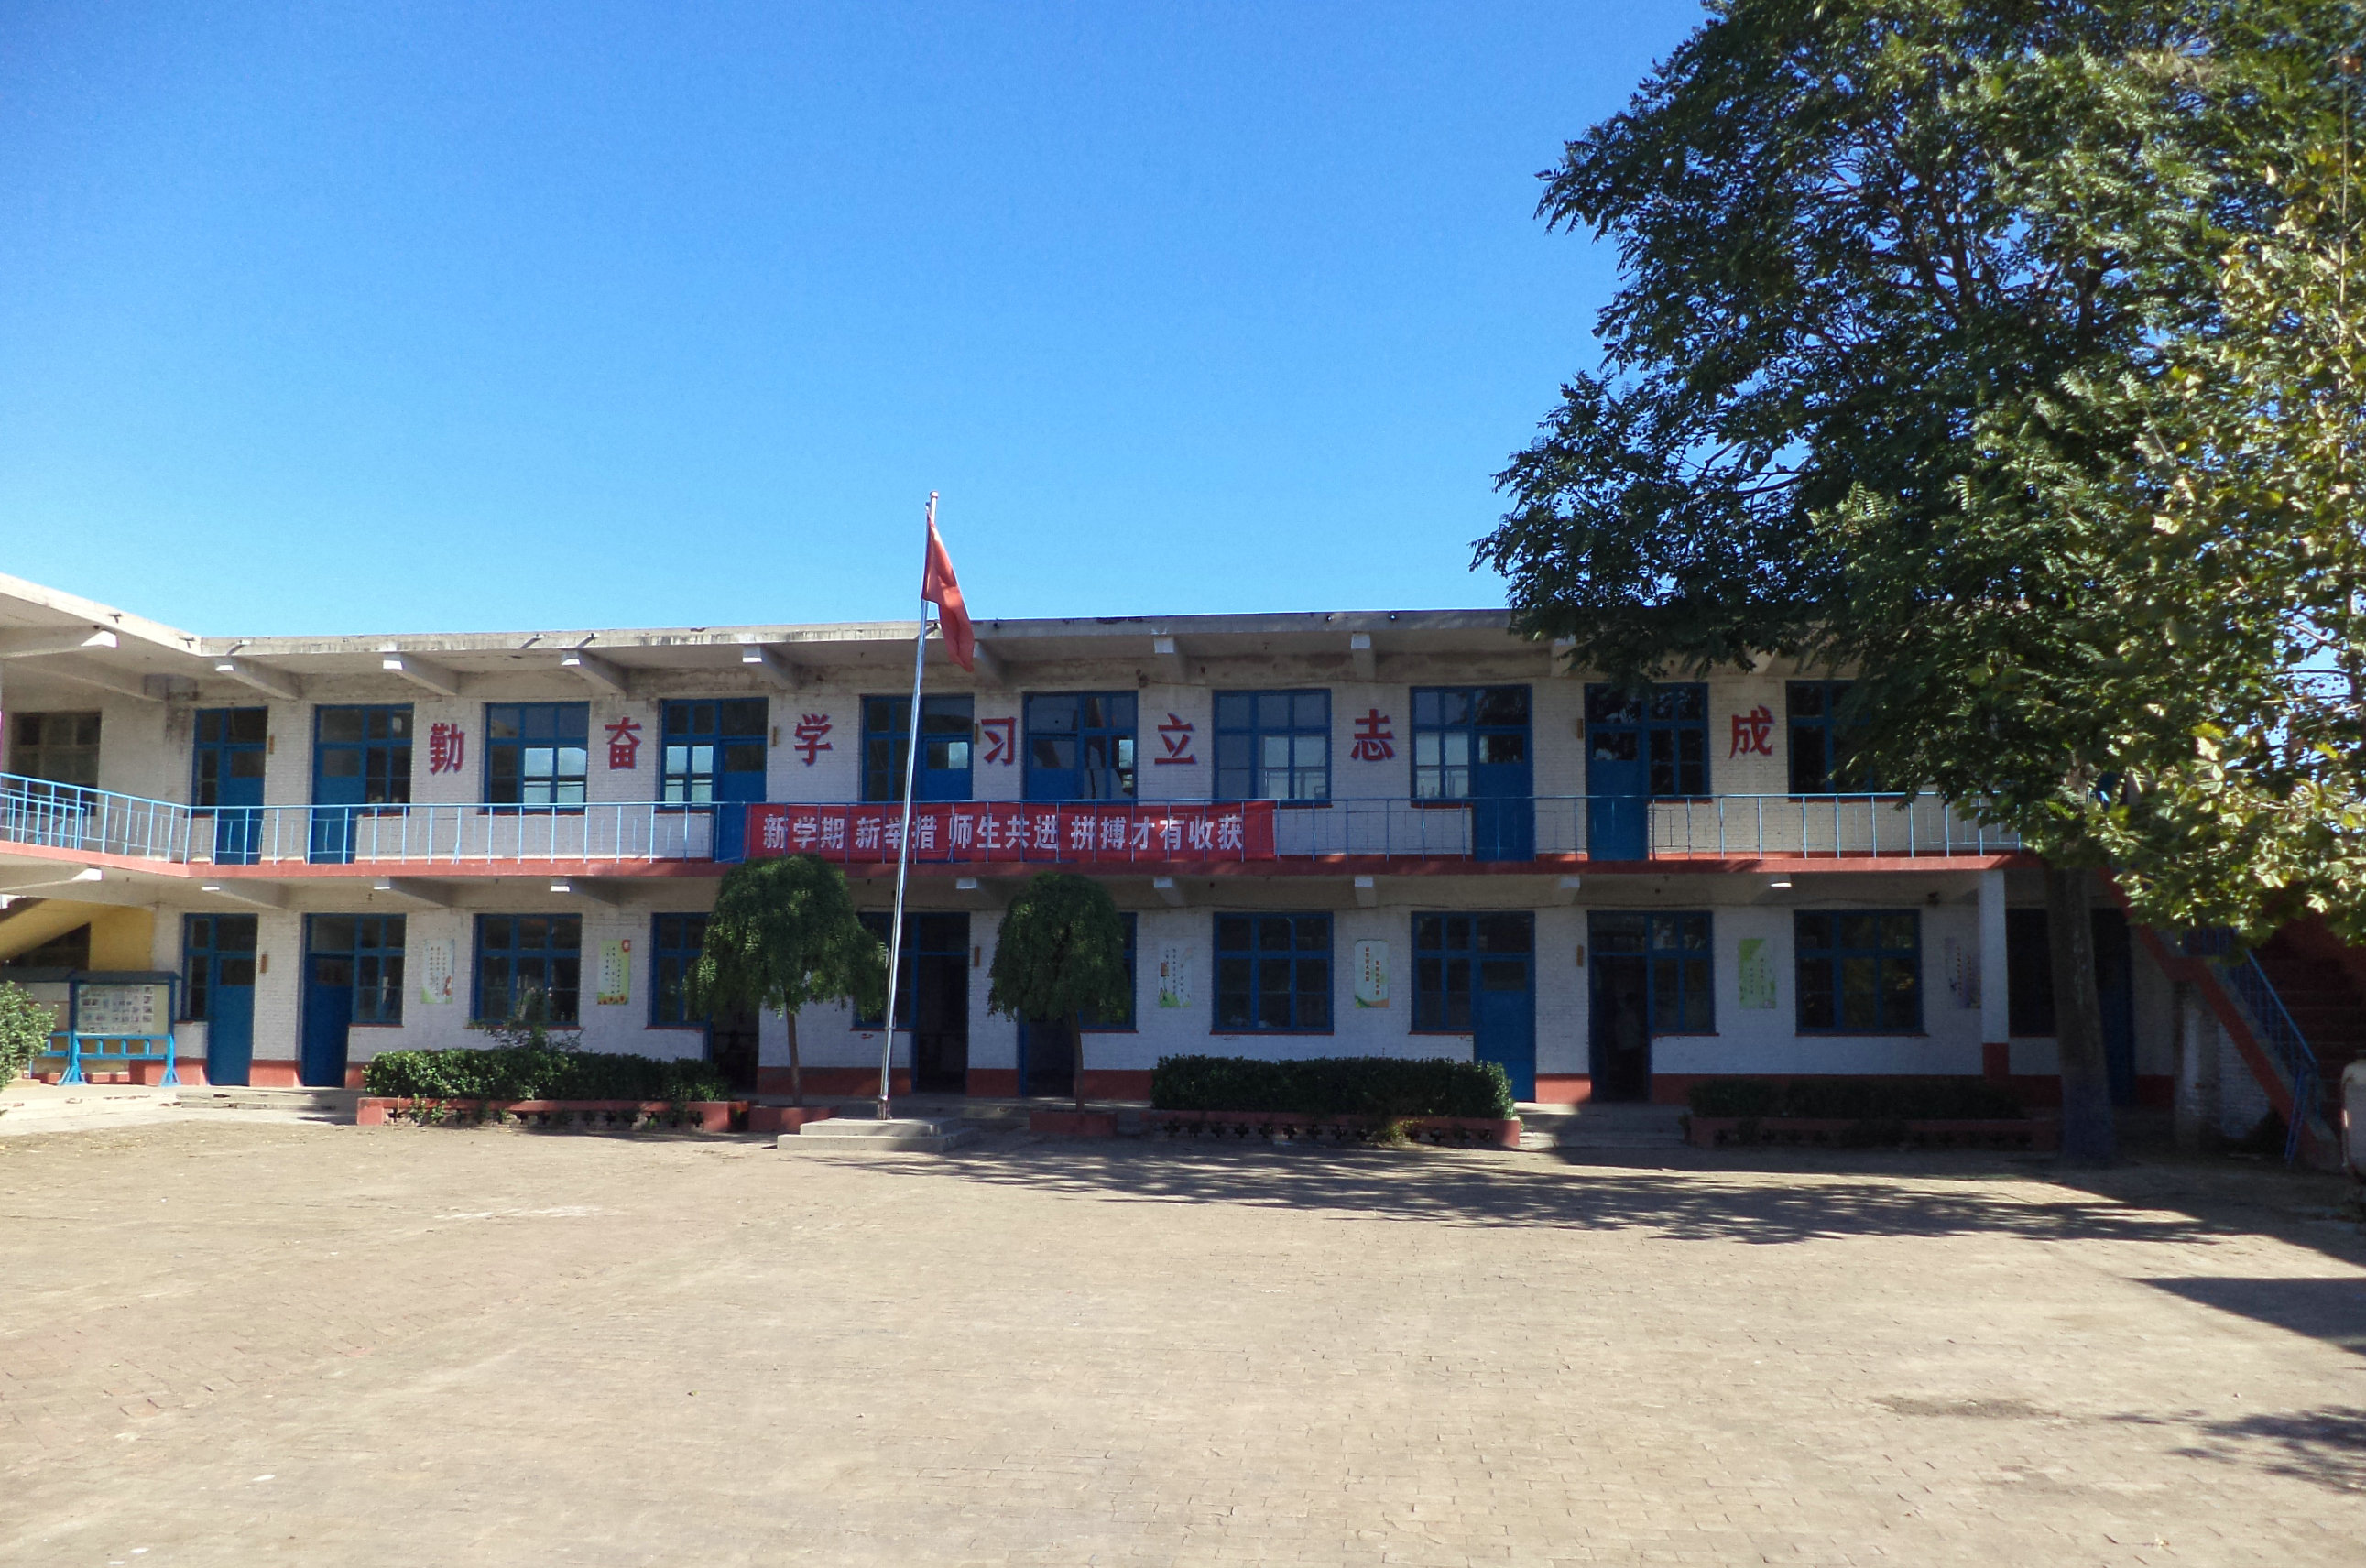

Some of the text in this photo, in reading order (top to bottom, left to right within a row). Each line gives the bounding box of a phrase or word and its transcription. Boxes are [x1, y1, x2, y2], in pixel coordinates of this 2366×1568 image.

[429, 705, 1774, 775] 勤 奋 学 习 立 志 成
[763, 812, 1243, 851] 新学期 新举措 师生共进 拼搏才有收获
